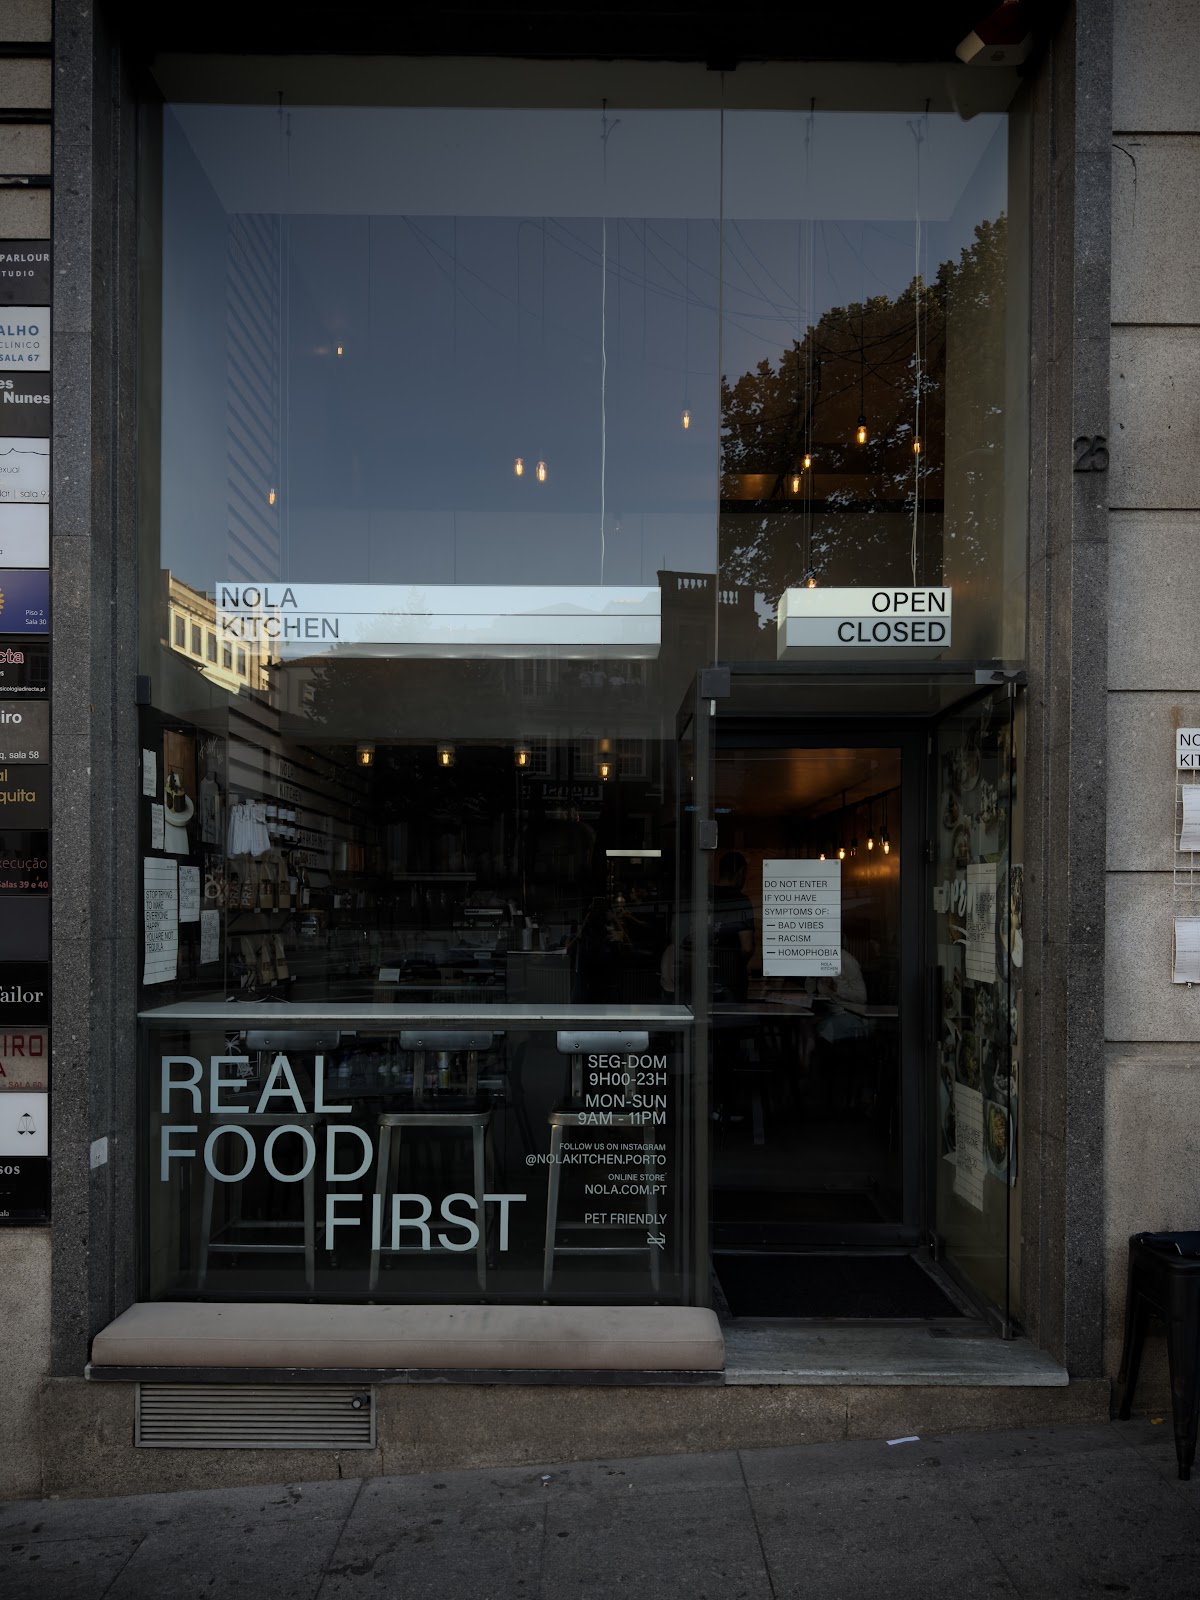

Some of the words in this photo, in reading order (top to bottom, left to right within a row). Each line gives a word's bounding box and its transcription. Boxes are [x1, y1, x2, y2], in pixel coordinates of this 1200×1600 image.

[0, 253, 50, 262] PARLOUR
[27, 354, 40, 362] 67
[3, 391, 51, 404] Nunes
[20, 489, 38, 498] sala
[222, 587, 298, 608] NOLA
[872, 592, 945, 613] OPEN
[25, 618, 38, 626] Sala
[39, 618, 47, 626] 30
[222, 616, 339, 638] KITCHEN
[837, 621, 946, 643] CLOSED
[1, 710, 22, 724] iro
[8, 751, 27, 759] sala
[28, 751, 40, 759] 58
[18, 880, 30, 889] 39
[37, 880, 48, 889] 40
[764, 880, 777, 888] DO
[779, 880, 797, 888] NOT
[799, 880, 828, 888] ENTER
[764, 894, 772, 902] IF
[773, 894, 792, 902] YOU
[794, 894, 817, 902] HAVE
[764, 908, 813, 916] SYMPTOMS
[814, 908, 830, 916] OF:
[778, 921, 797, 929] BAD
[798, 921, 824, 929] VIBES
[778, 934, 811, 942] RACISM
[778, 949, 839, 957] HOMOPHOBIA
[0, 985, 44, 1003] ailor
[3, 1035, 43, 1057] IRO
[587, 1054, 667, 1069] SEG-DOM
[8, 1081, 31, 1089] SALA
[32, 1081, 43, 1089] 60
[160, 1055, 353, 1114] REAL
[588, 1072, 667, 1086] 9H00-23H
[585, 1094, 667, 1109] MON-SUN
[577, 1111, 613, 1125] 9AM
[629, 1112, 667, 1125] 11PM
[559, 1143, 592, 1151] FOLLOW
[593, 1143, 605, 1151] US
[606, 1143, 619, 1151] ON
[620, 1143, 666, 1151] INSTAGRAM
[160, 1124, 374, 1184] FOOD
[525, 1154, 667, 1167] @NOLAKITCHEN.PORTO
[608, 1173, 638, 1181] ONLINE
[639, 1173, 666, 1181] STORE
[584, 1184, 668, 1196] NOLA.COM.PT
[325, 1192, 527, 1252] FIRST
[584, 1213, 607, 1224] PET
[610, 1213, 668, 1225] FRIENDLY
